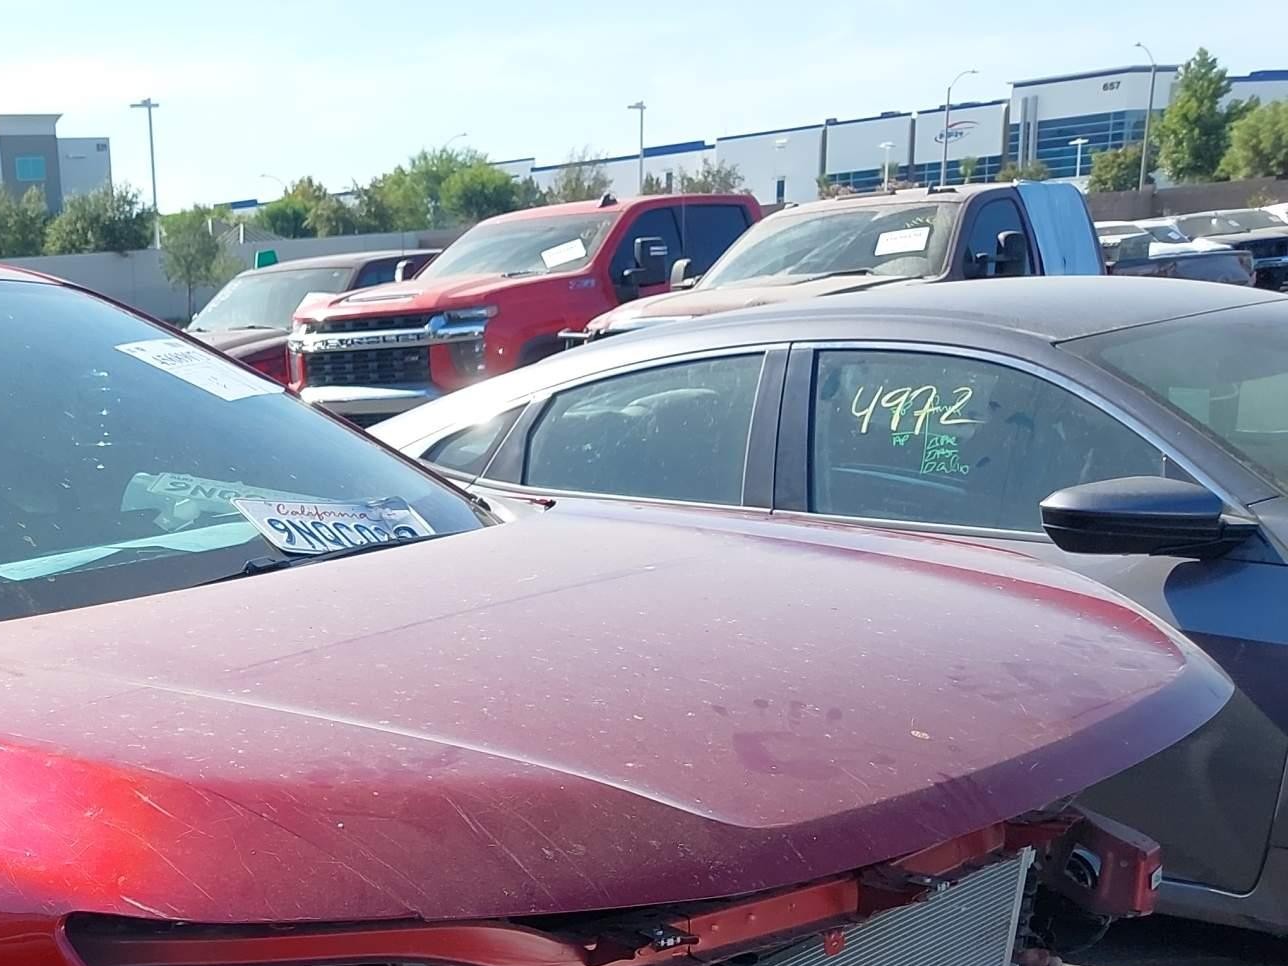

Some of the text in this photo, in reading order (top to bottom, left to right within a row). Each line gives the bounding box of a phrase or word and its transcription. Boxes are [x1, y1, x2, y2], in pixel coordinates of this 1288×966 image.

[1102, 81, 1121, 92] 657
[852, 385, 985, 435] 4972
[277, 503, 383, 521] California
